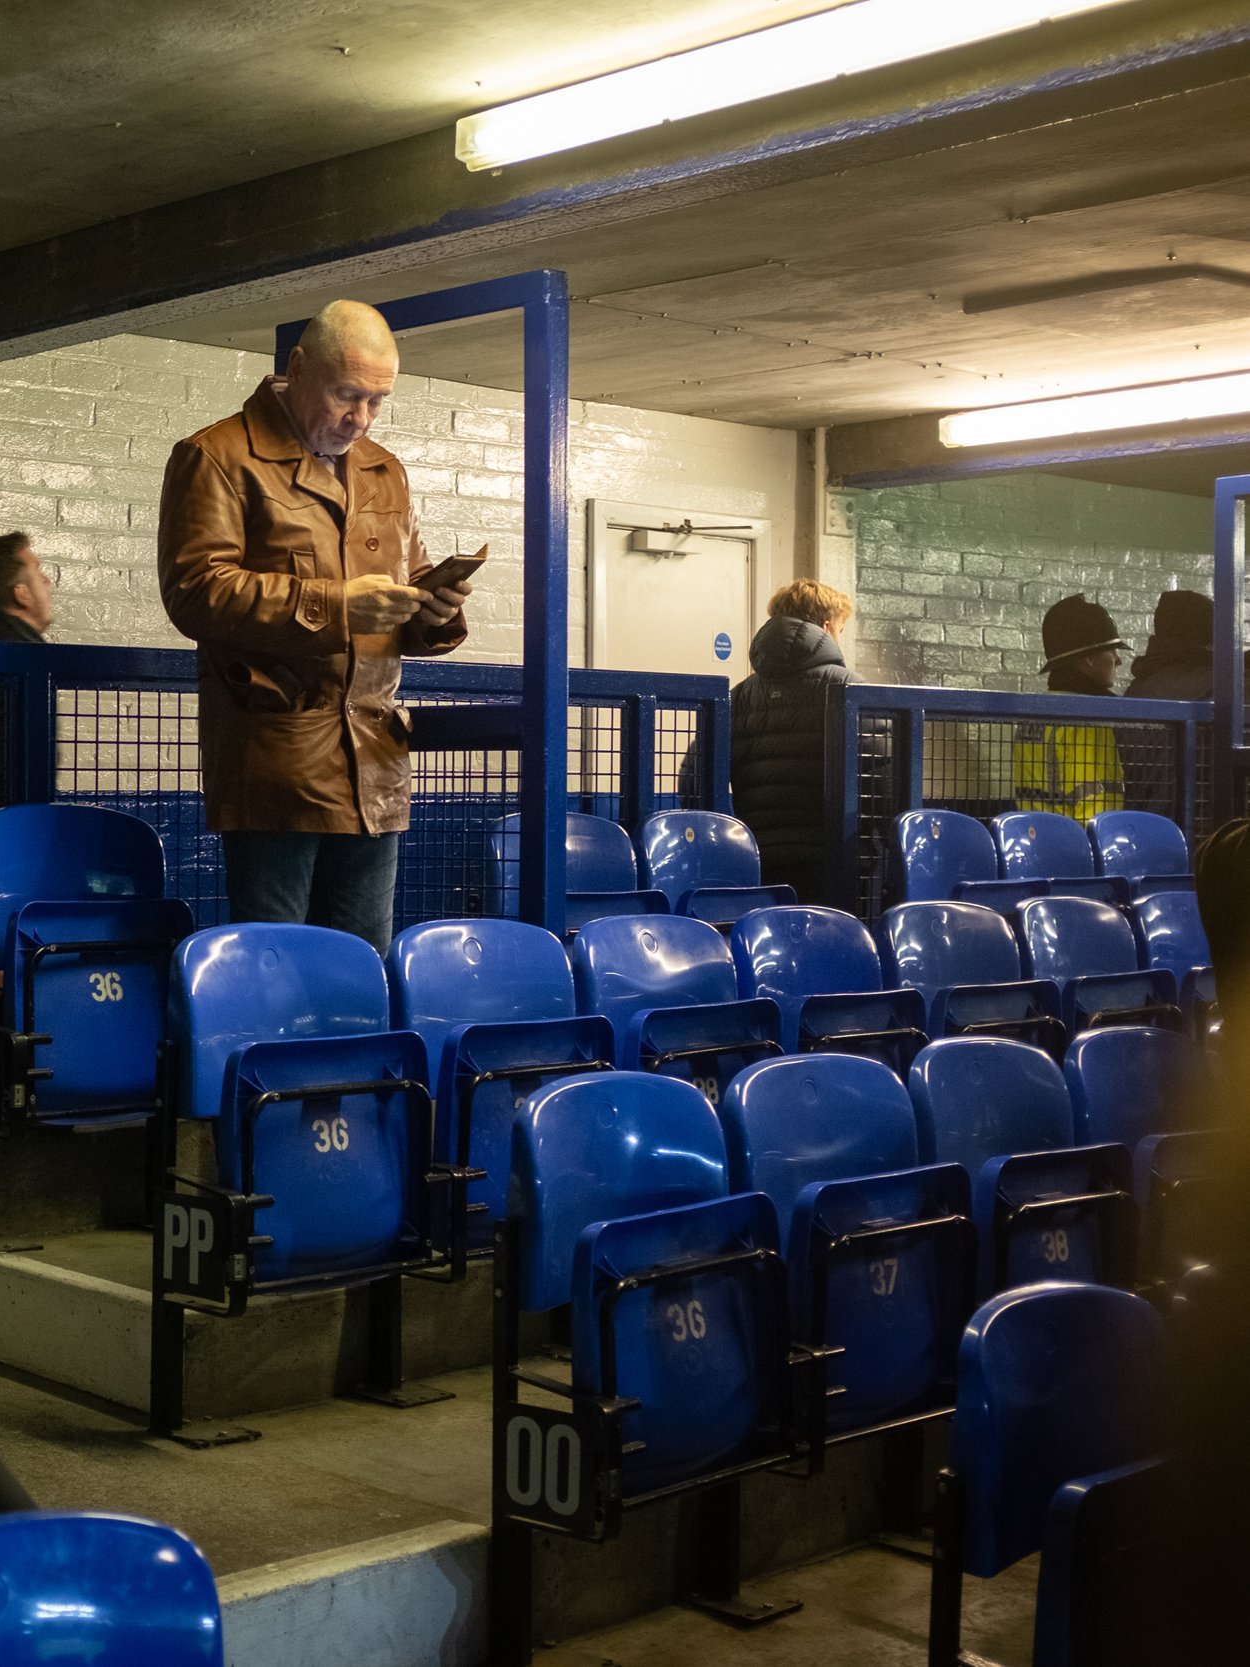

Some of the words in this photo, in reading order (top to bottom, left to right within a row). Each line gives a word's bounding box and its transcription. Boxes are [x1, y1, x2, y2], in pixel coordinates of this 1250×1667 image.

[89, 972, 123, 1002] 36
[313, 1118, 349, 1153] 36
[163, 1203, 214, 1285] PP
[1041, 1229, 1069, 1263] 38
[869, 1258, 899, 1296] 37
[667, 1300, 706, 1342] 36
